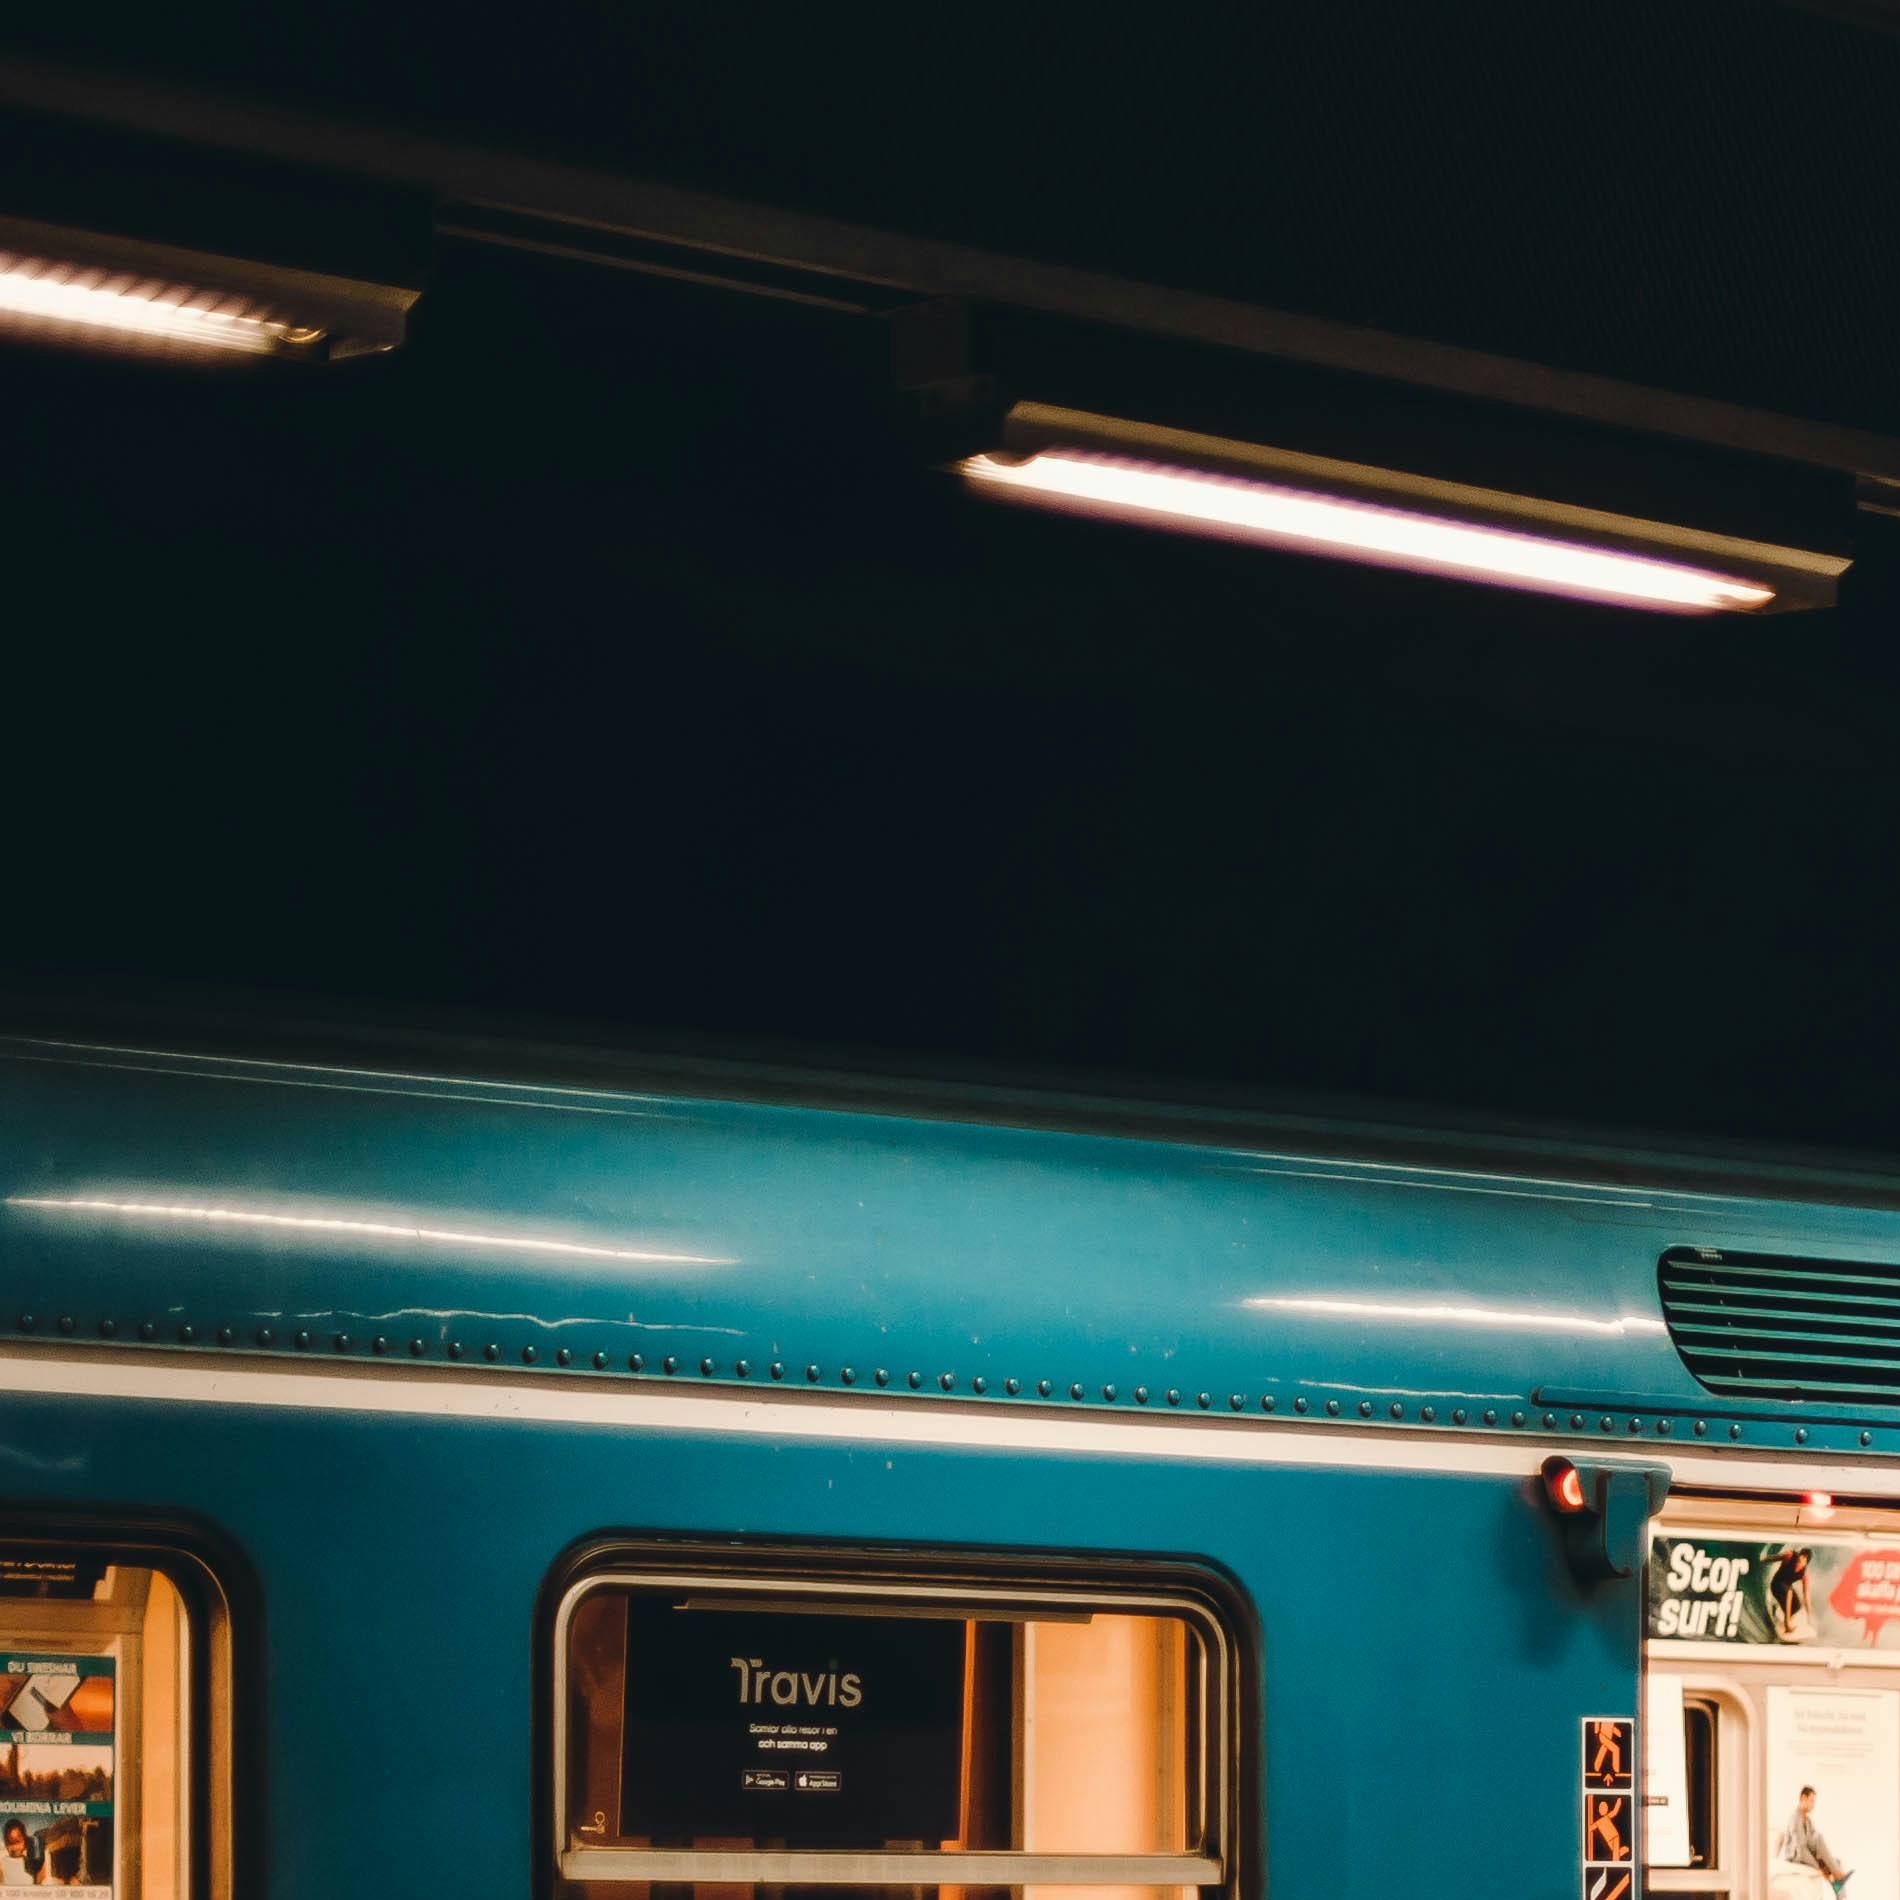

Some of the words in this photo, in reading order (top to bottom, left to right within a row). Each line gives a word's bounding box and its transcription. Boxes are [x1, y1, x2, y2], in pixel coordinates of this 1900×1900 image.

[1667, 1542, 1749, 1594] Stor
[1657, 1590, 1744, 1638] surf!
[731, 1657, 862, 1707] Travis
[809, 1741, 828, 1752] app
